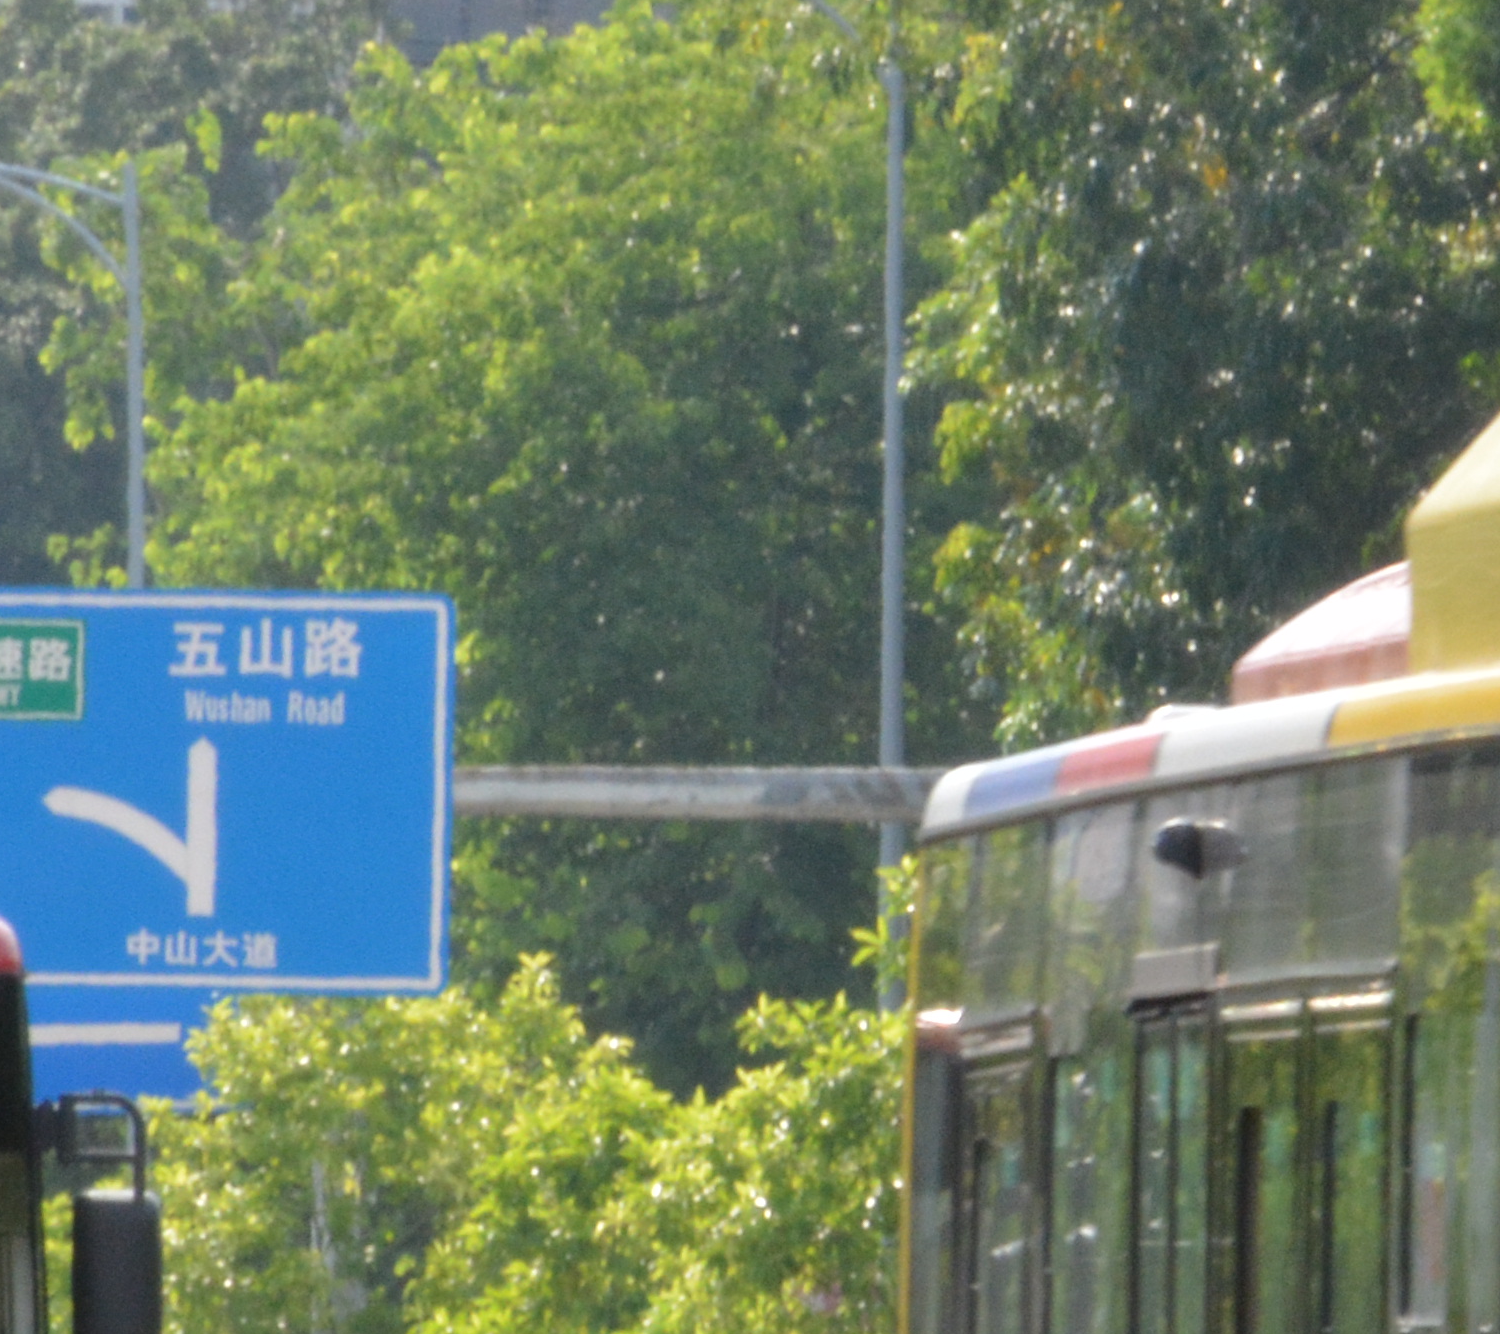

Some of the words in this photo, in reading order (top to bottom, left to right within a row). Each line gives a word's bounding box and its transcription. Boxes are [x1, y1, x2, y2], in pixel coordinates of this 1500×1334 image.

[168, 617, 363, 679] 五山路
[184, 689, 273, 725] Wushan
[286, 689, 347, 727] Road
[126, 926, 278, 969] 中山大道
